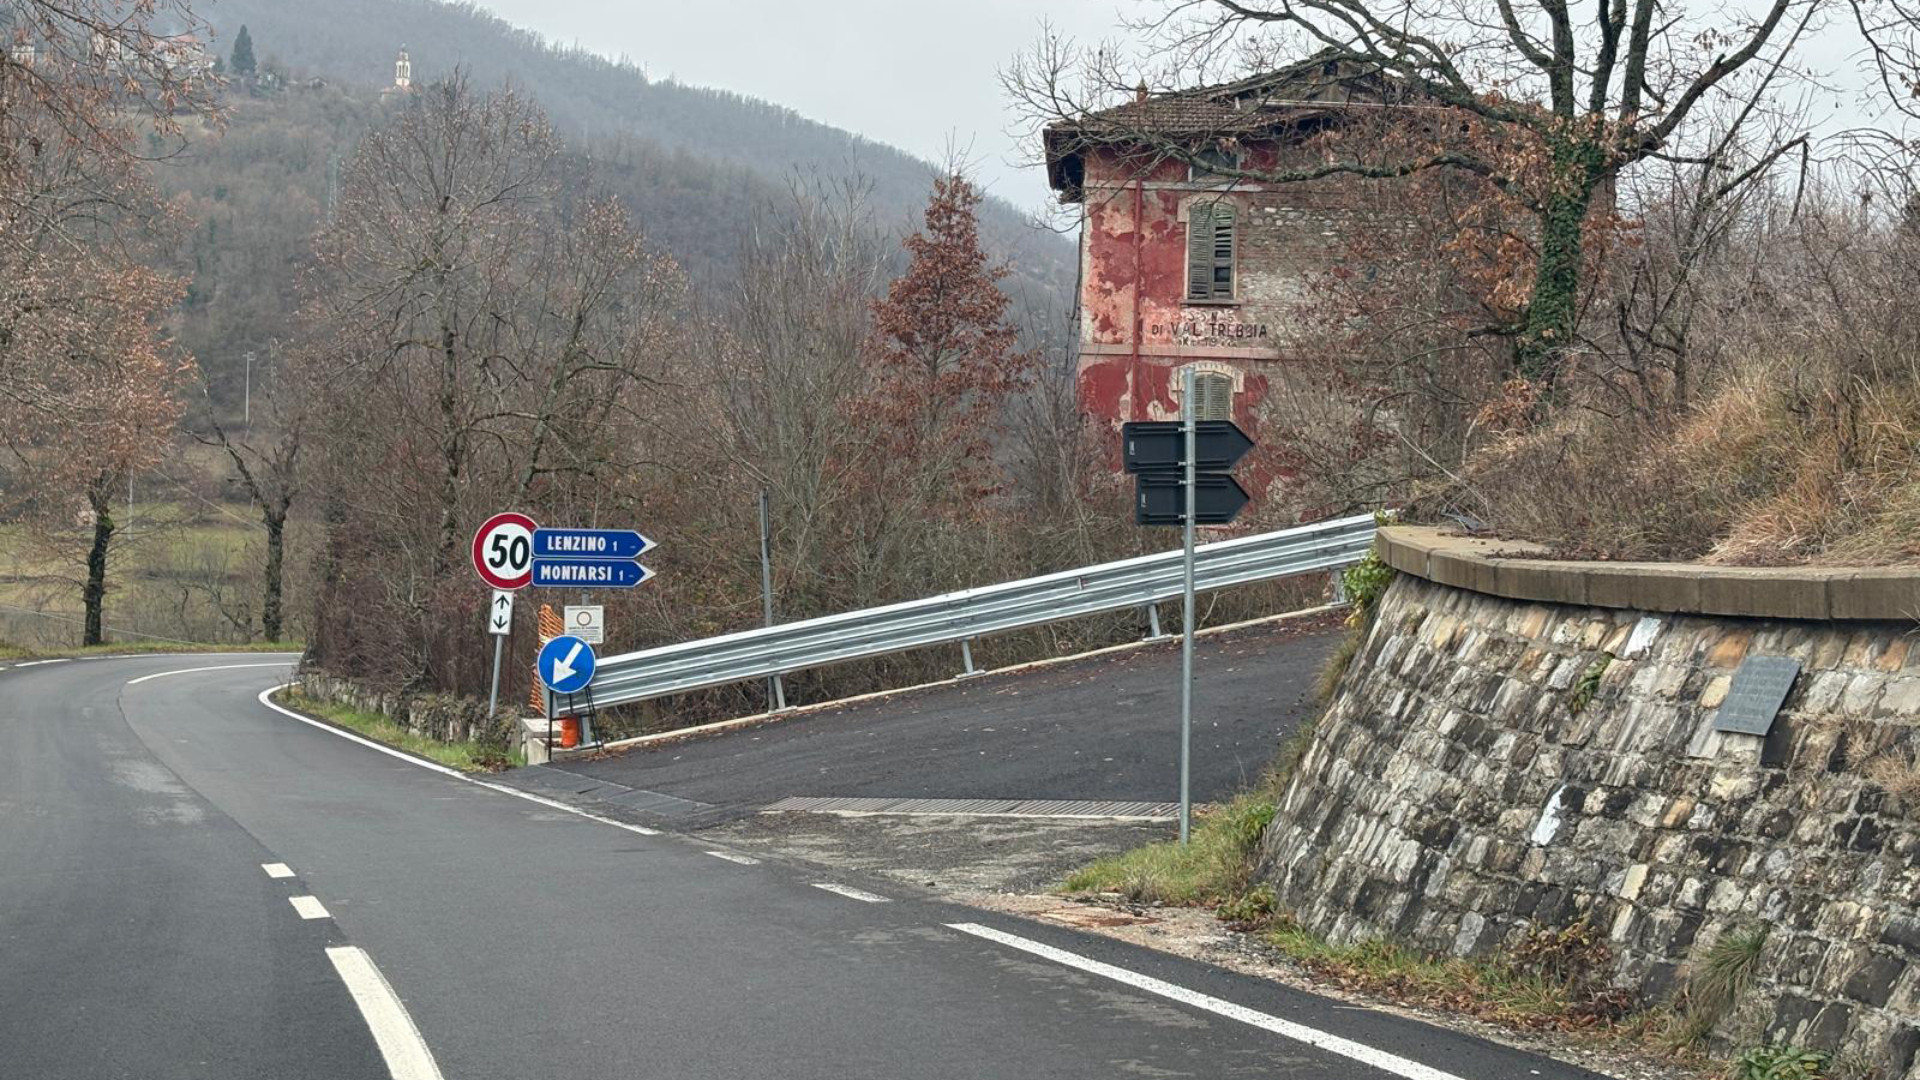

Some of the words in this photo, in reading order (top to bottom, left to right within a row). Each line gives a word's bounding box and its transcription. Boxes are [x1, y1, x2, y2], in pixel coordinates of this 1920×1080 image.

[1151, 324, 1164, 336] DI
[1170, 322, 1202, 337] VAL
[547, 535, 607, 552] LENZINO
[612, 541, 618, 552] 1
[489, 534, 530, 571] 50
[540, 565, 612, 581] MONTARSI
[619, 571, 624, 581] 1
